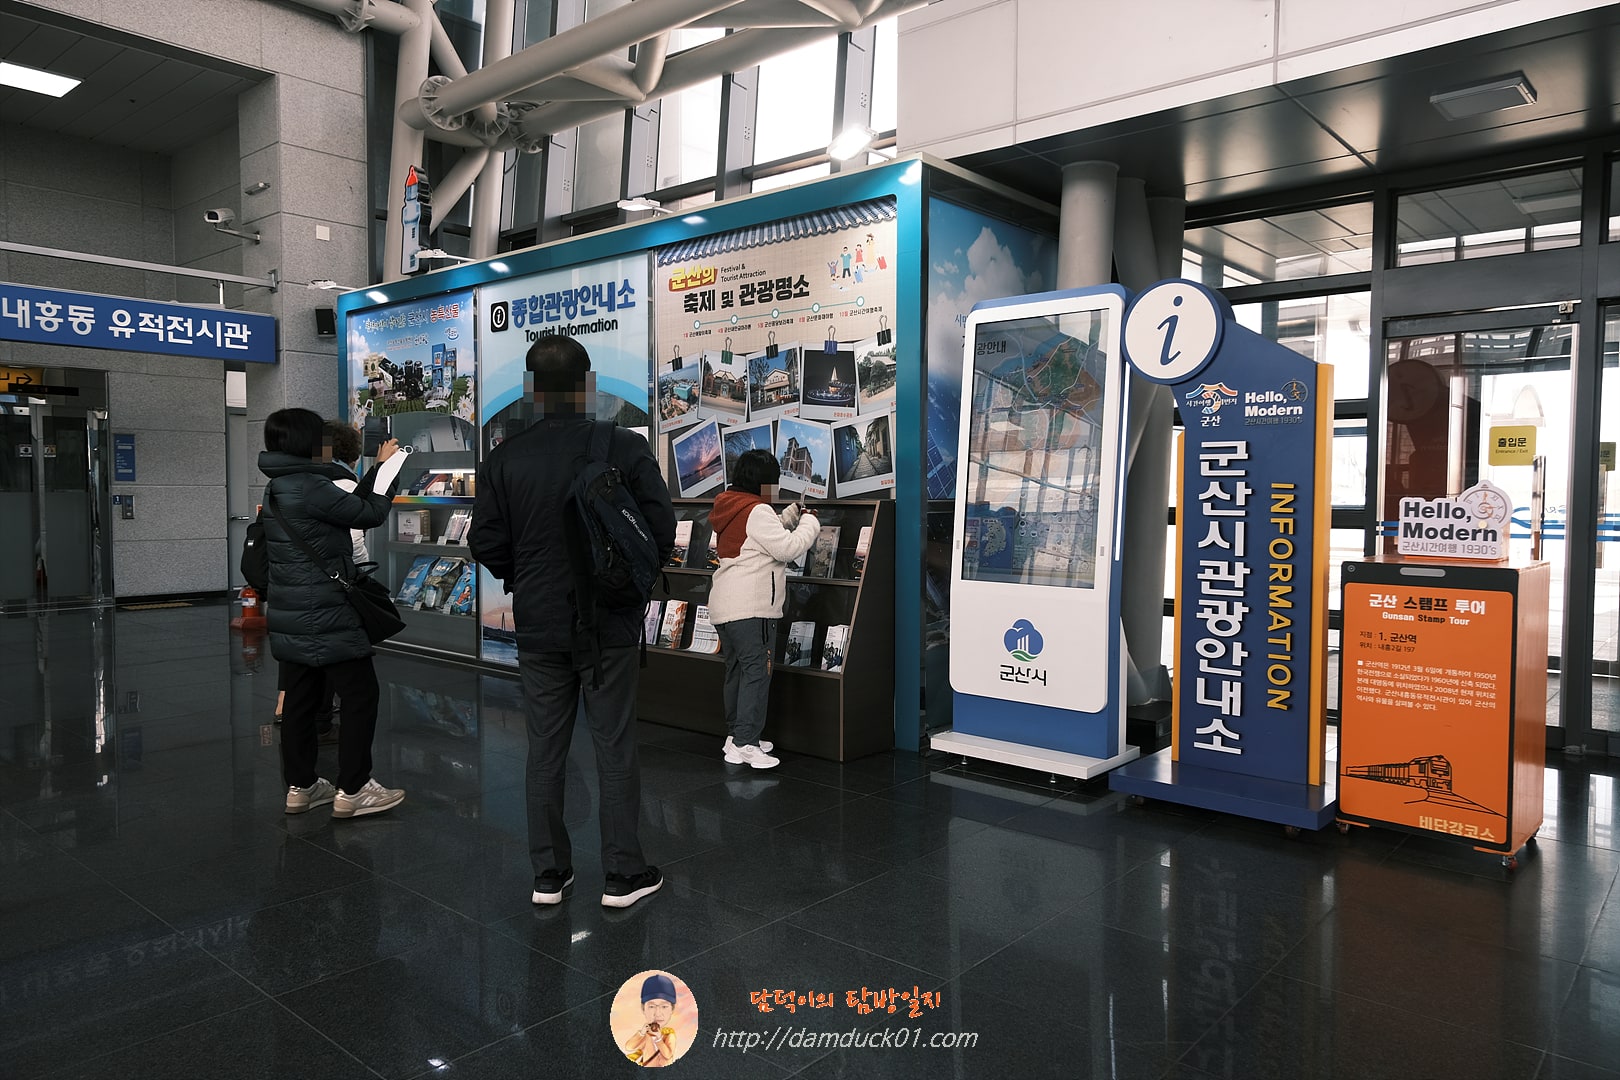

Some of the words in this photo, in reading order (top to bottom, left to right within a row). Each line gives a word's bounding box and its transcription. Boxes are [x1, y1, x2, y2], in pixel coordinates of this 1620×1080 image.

[670, 264, 716, 289] 군산의
[720, 265, 740, 274] Festival
[720, 273, 739, 283] Tourist
[739, 269, 766, 280] Attraction
[684, 291, 716, 314] 축제
[721, 291, 734, 307] 및
[738, 274, 810, 306] 관광명소
[511, 278, 636, 329] 종합관광안내소
[1, 297, 96, 335] 내흥동
[108, 309, 252, 350] 유적전시관
[524, 326, 556, 343] Tourist
[558, 318, 618, 336] Information
[977, 340, 1006, 356] 광안내
[1244, 391, 1287, 404] Hello,
[1244, 404, 1303, 417] Modern
[1200, 415, 1221, 428] 군산
[1244, 417, 1278, 426] 군산시간여행
[1498, 438, 1527, 448] 출입문
[1404, 501, 1472, 523] Hello,
[1402, 522, 1498, 542] Modern
[1402, 541, 1457, 554] 군산시간여행
[1193, 440, 1252, 755] 군산시관광안내소
[1266, 482, 1295, 711] INFORMATION
[1368, 594, 1398, 608] 군산
[1404, 596, 1448, 612] 스탬프
[1454, 599, 1486, 616] 투어
[1382, 612, 1414, 622] Gunsan
[1418, 614, 1446, 624] Stamp
[1449, 616, 1470, 626] Tour
[1360, 630, 1373, 639] 지점
[1378, 632, 1387, 641] 1.
[1390, 633, 1417, 644] 군산역
[1360, 642, 1373, 650] 위치
[1378, 643, 1402, 652] 내흥2길
[1000, 664, 1047, 686] 군산시
[1357, 668, 1392, 678] 한국전쟁으로
[1365, 660, 1389, 669] 군산역은
[1474, 672, 1496, 680] 1950년
[1434, 686, 1458, 696] 2008년
[1474, 700, 1496, 709] 군산의
[1419, 816, 1495, 842] 비단강코스
